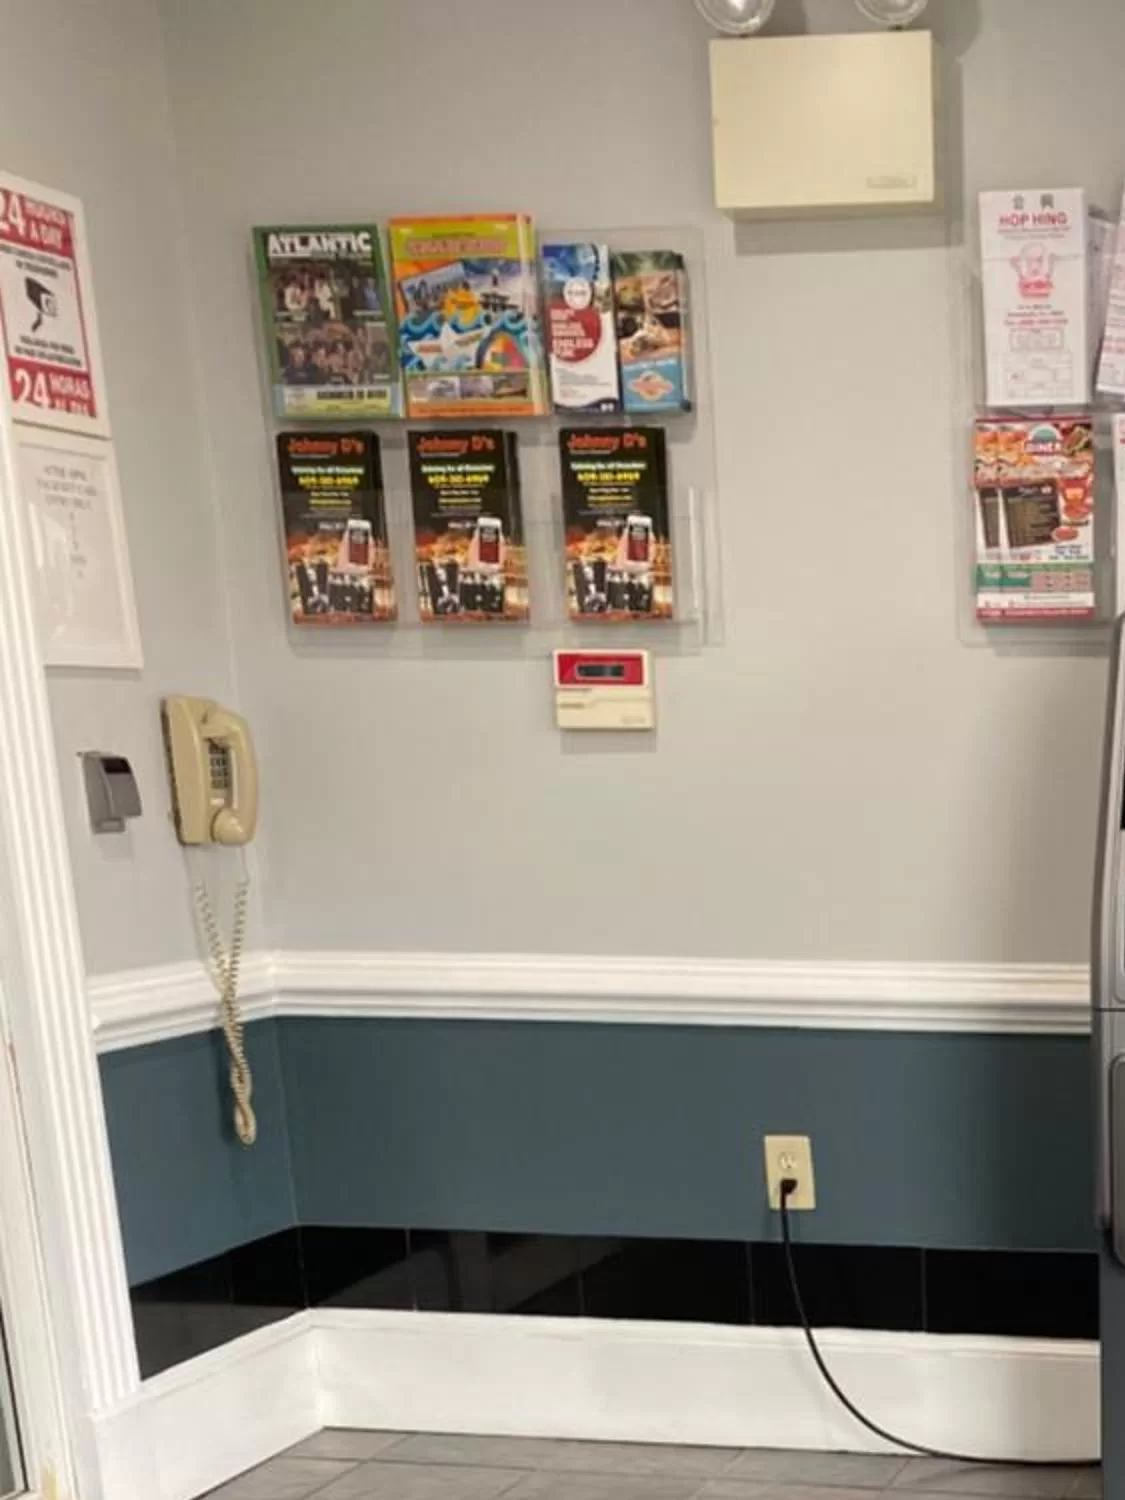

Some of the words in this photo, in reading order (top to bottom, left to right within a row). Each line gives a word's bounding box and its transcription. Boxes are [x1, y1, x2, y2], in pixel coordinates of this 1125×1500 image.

[999, 213, 1029, 226] HOP
[1031, 212, 1068, 225] HING
[268, 232, 372, 254] ATLANTIC
[15, 368, 49, 405] 24
[288, 437, 338, 454] Johnny
[341, 437, 364, 454] D's
[416, 436, 468, 453] Johnny
[471, 435, 495, 450] D's
[567, 434, 619, 451] Johnny
[623, 432, 647, 448] D's
